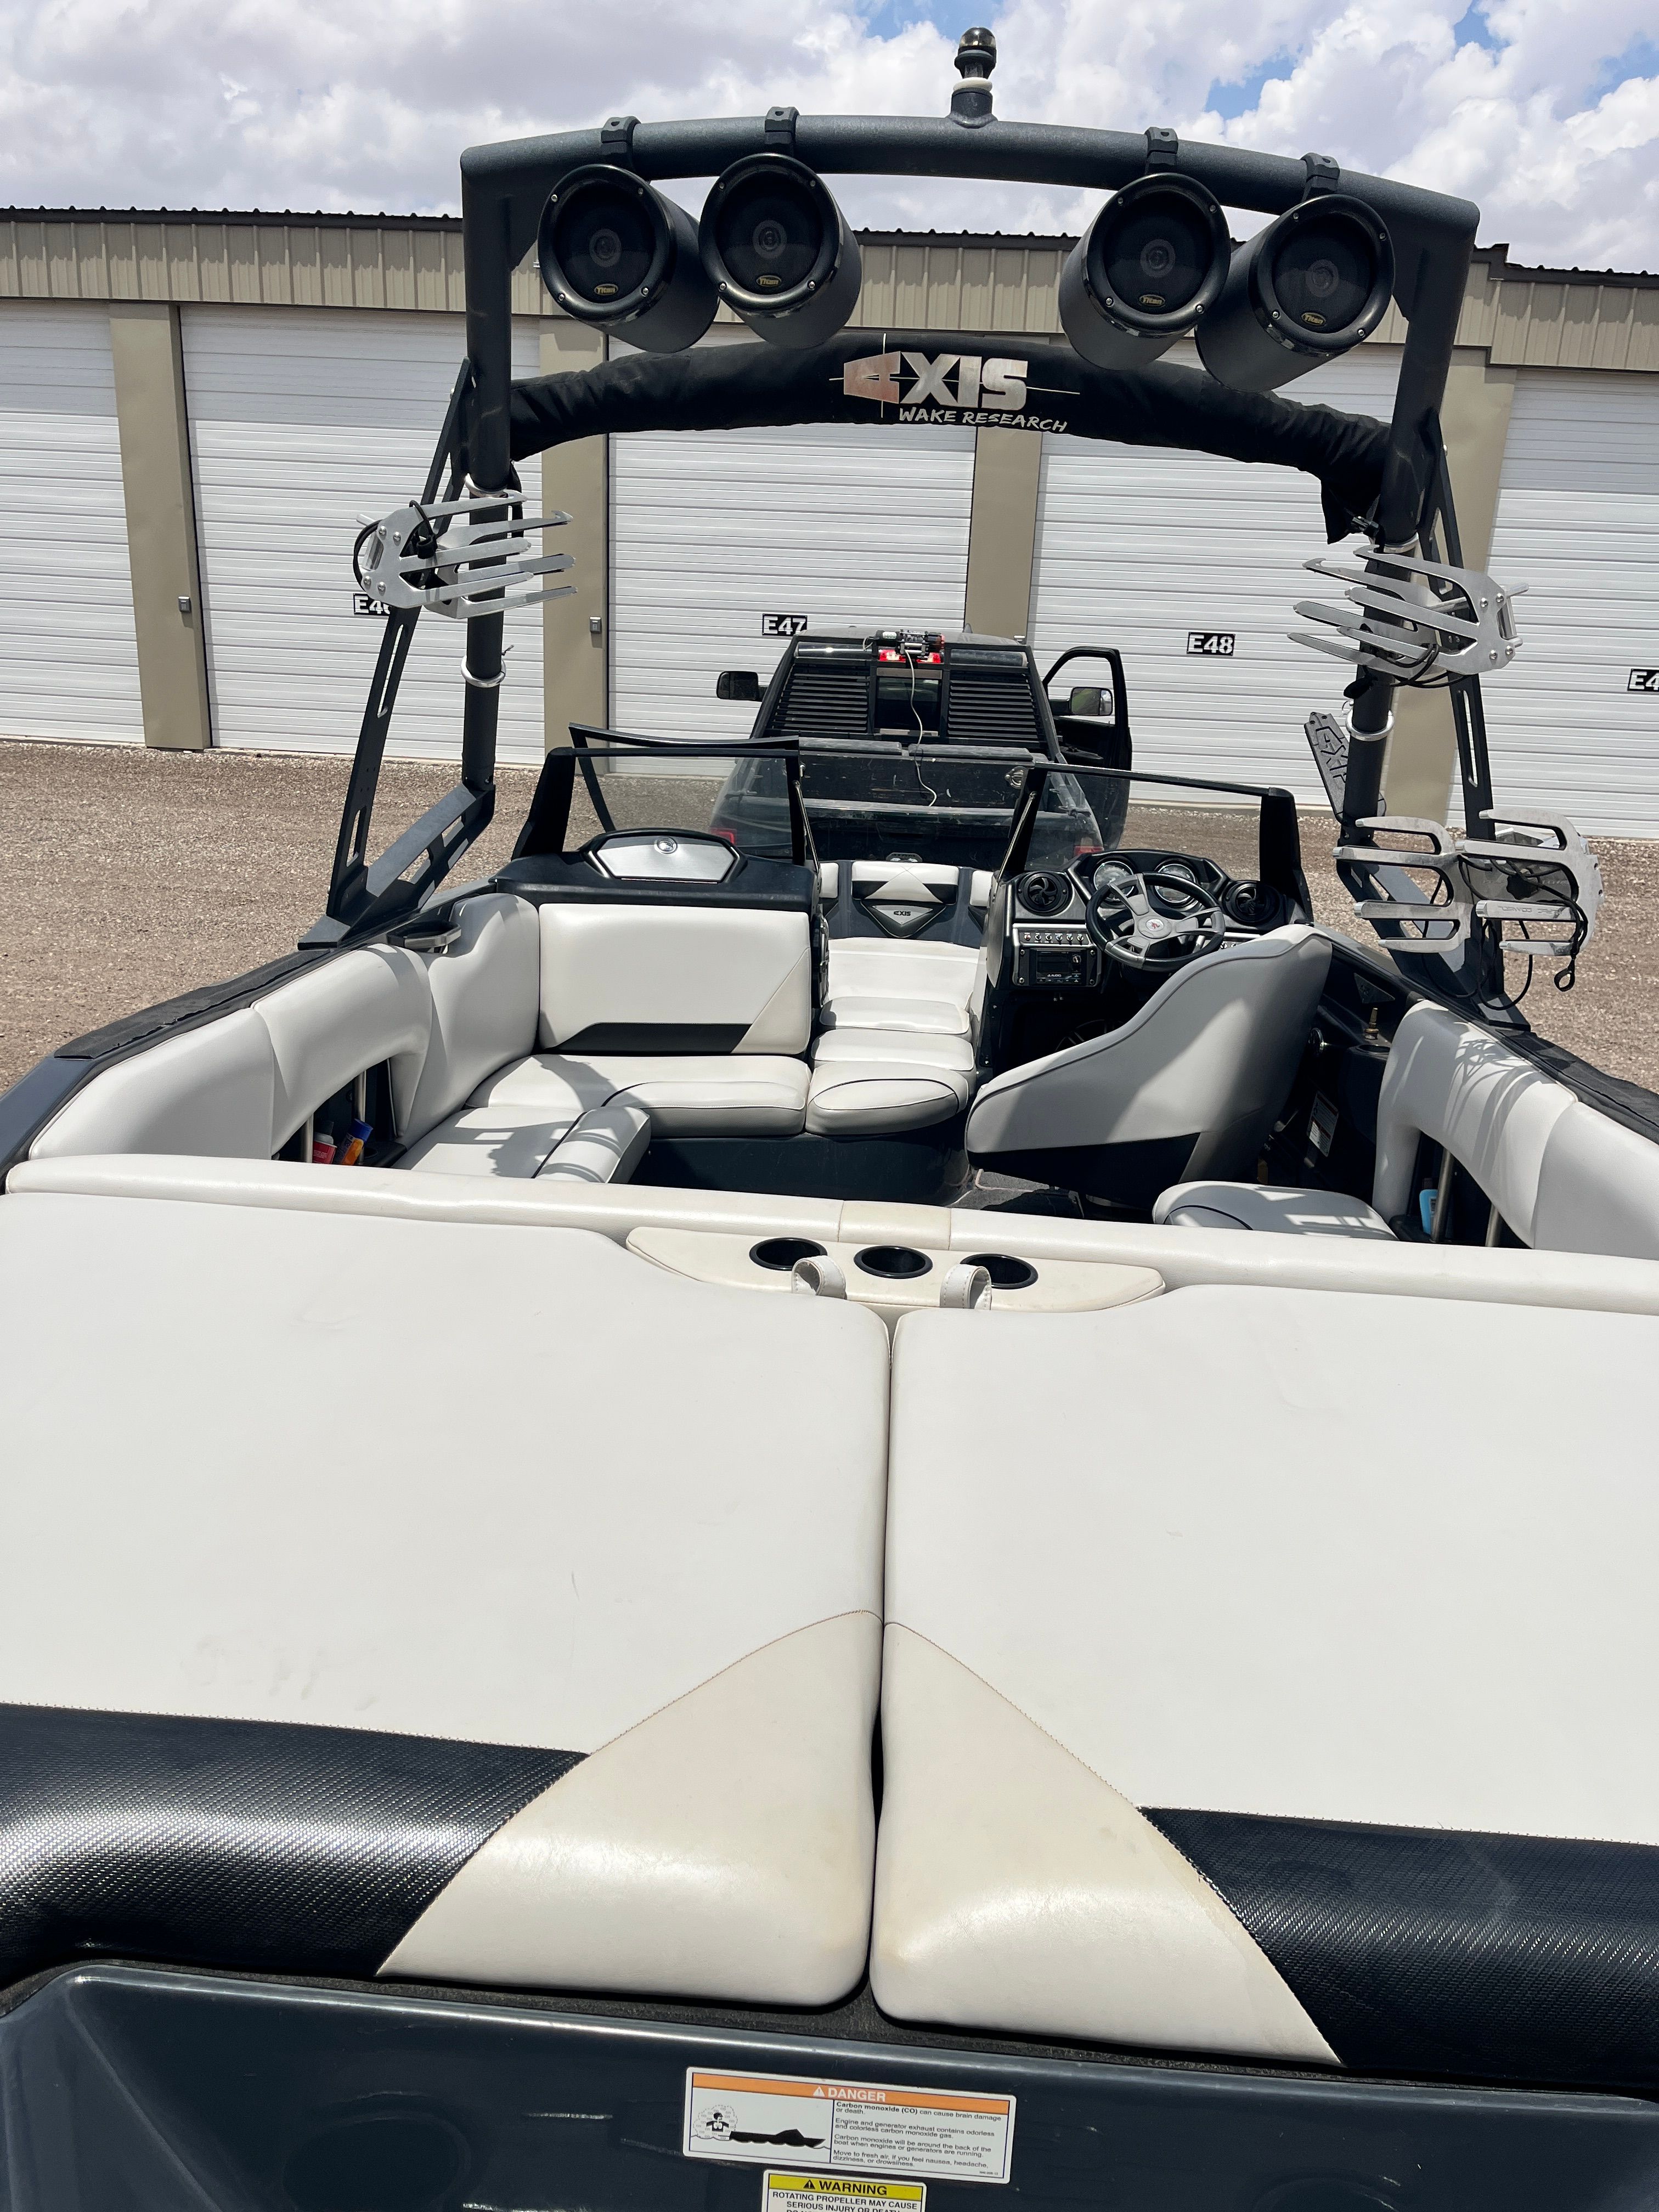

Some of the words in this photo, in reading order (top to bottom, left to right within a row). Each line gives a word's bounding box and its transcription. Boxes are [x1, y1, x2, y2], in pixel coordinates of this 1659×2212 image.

[844, 351, 1028, 410] AXIS
[899, 407, 957, 424] WAKE
[963, 411, 1068, 432] RESEARCH
[763, 616, 806, 636] E47
[1188, 634, 1233, 654] E48
[828, 2087, 886, 2102] DANGER
[819, 2181, 887, 2195] WARNING
[773, 2192, 814, 2200] ROTATING
[817, 2196, 866, 2205] PROPELLER
[787, 2202, 823, 2210] SERIOUS
